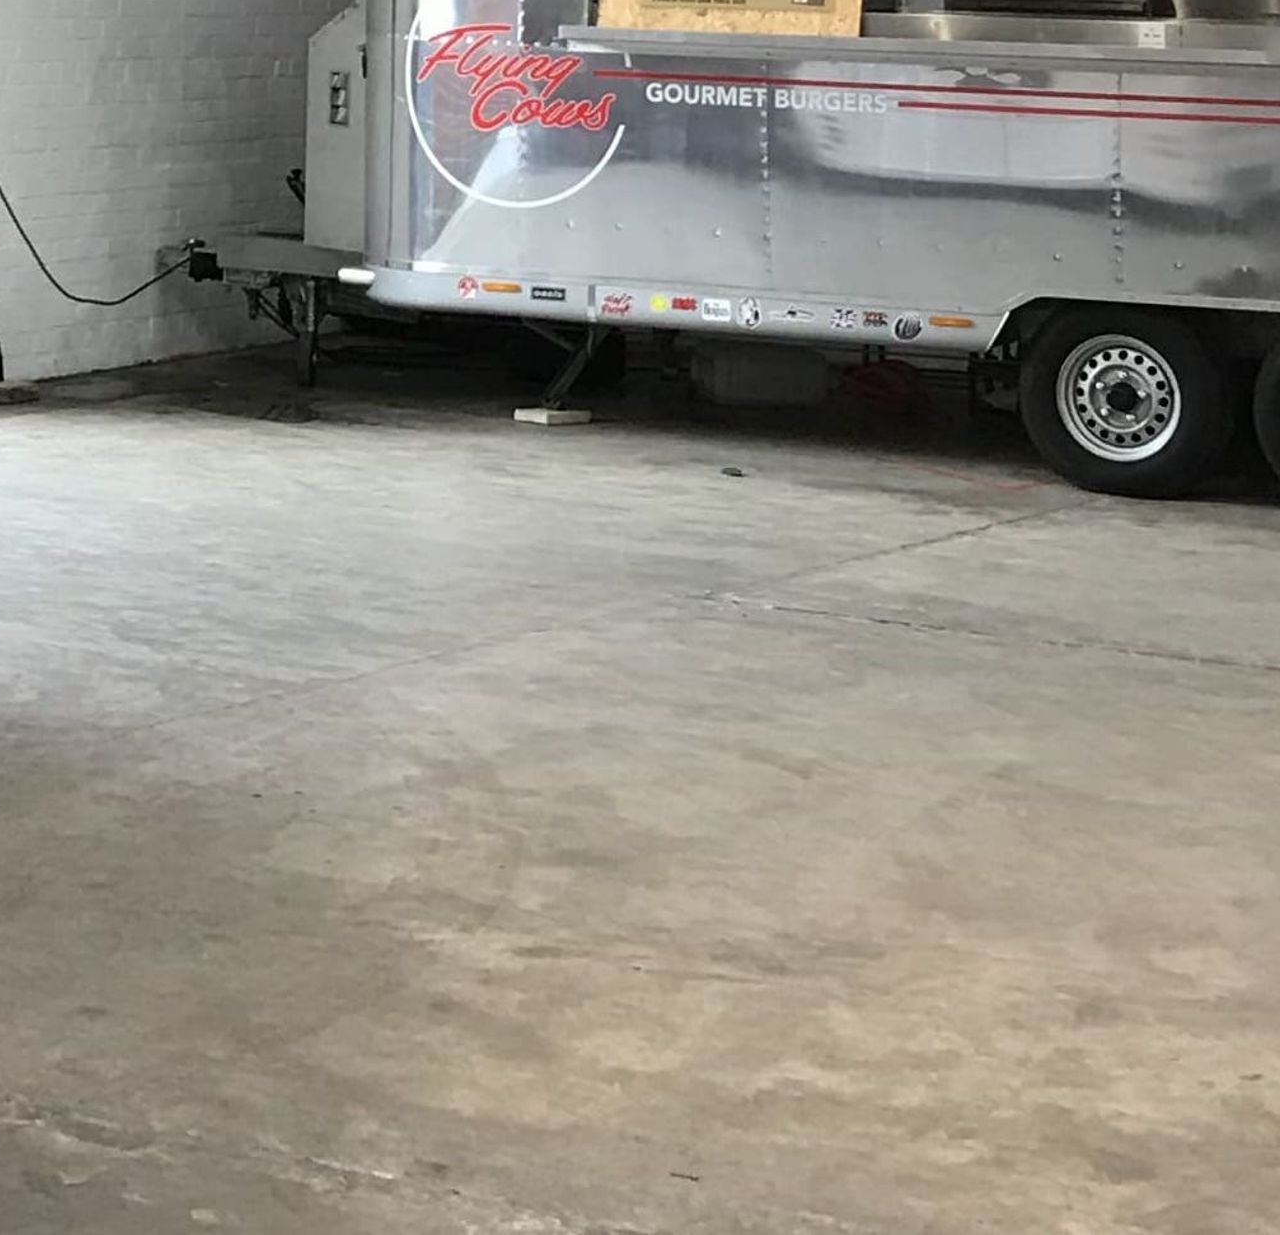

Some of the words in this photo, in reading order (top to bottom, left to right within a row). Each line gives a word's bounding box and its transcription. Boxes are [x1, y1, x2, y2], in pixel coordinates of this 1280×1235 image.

[416, 22, 583, 99] Flying
[471, 78, 616, 132] Cows
[645, 82, 767, 108] GOURMET
[774, 88, 888, 114] BURGERS
